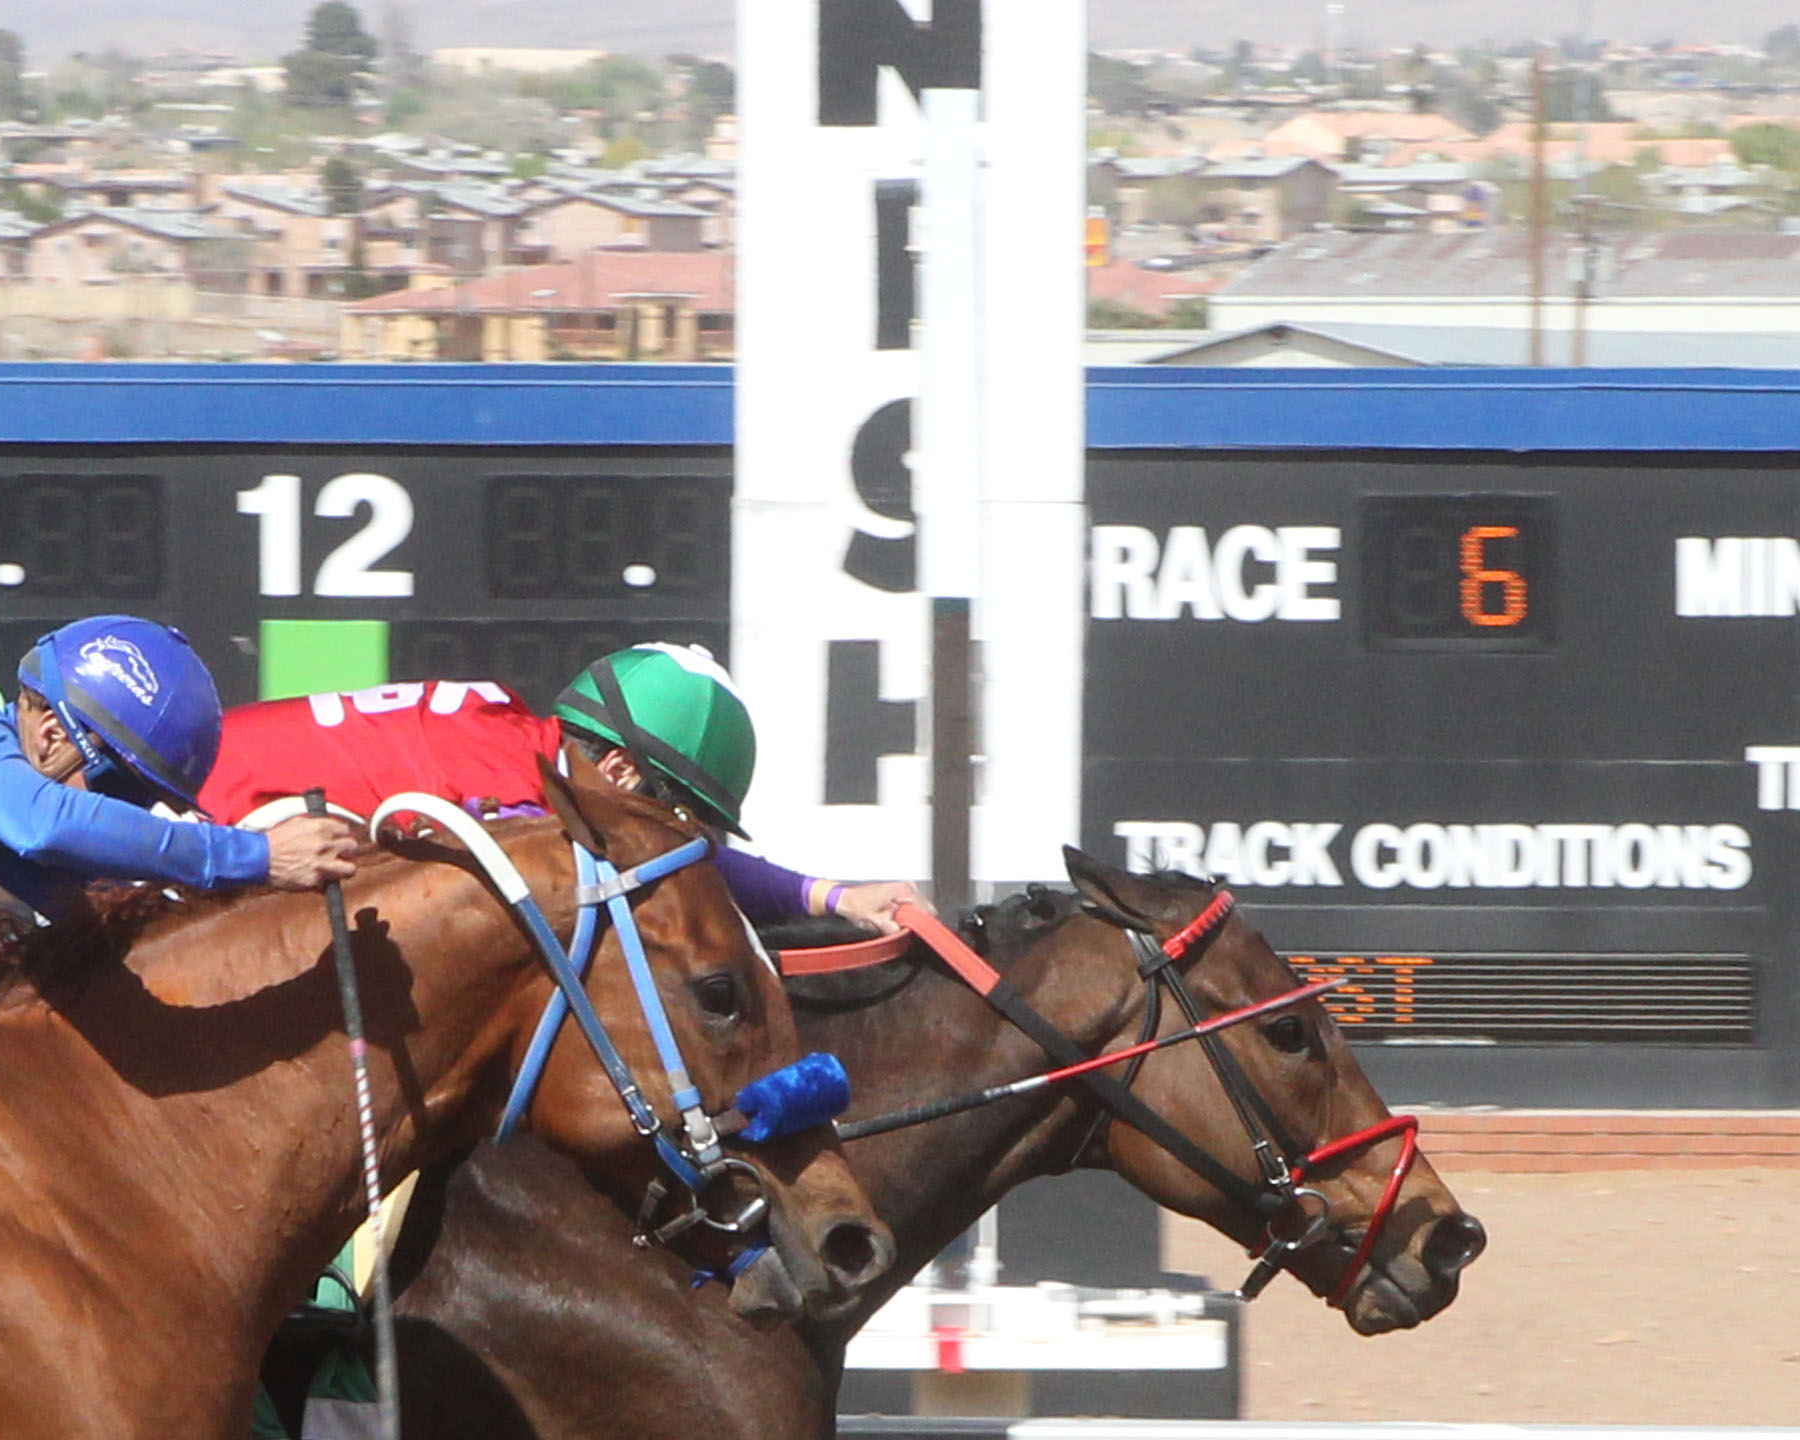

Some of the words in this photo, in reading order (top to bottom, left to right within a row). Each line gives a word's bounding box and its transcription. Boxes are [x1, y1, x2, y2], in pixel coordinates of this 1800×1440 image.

[236, 473, 415, 598] 12
[1090, 524, 1342, 622] RACE
[1459, 525, 1528, 628] 6
[1113, 821, 1345, 887] TRACK
[1351, 822, 1753, 889] CONDITIONS
